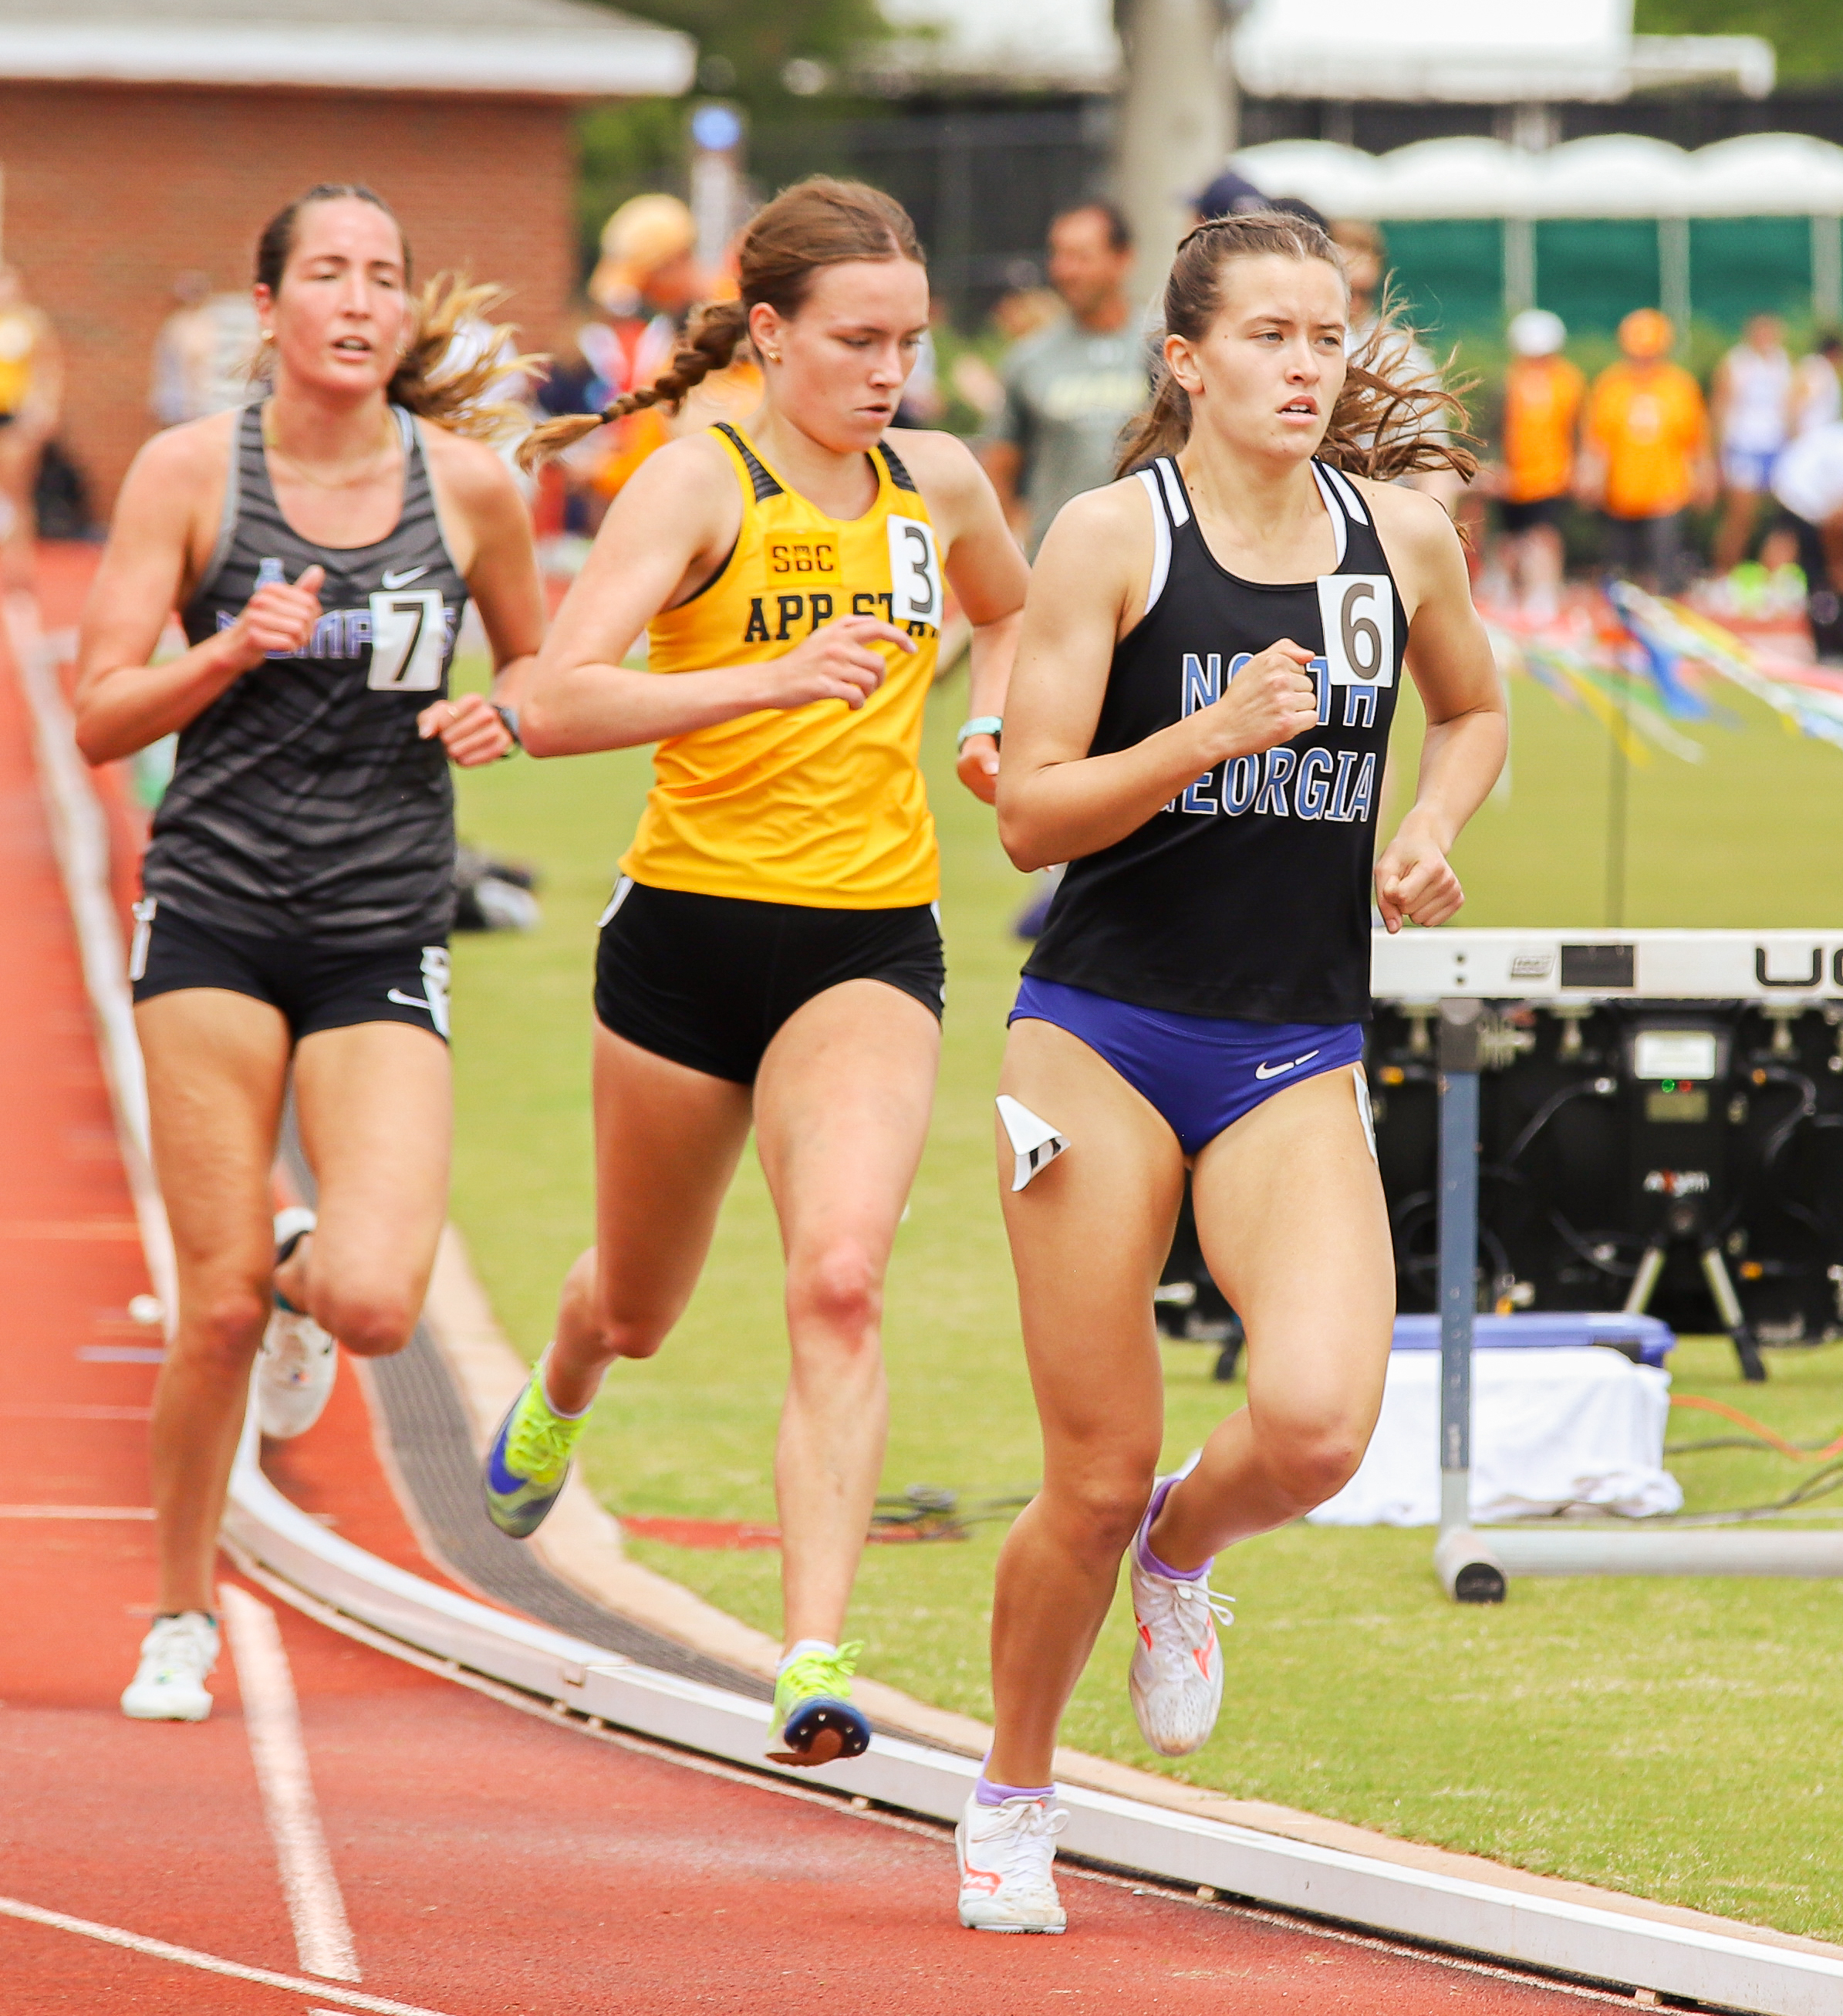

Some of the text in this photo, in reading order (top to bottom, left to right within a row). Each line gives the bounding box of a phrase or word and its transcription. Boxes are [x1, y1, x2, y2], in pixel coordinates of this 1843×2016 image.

[772, 545, 834, 572] SBC
[904, 526, 933, 614] 3
[393, 602, 424, 681] 7
[744, 593, 833, 642] APP
[1341, 583, 1382, 680] 6
[1159, 747, 1376, 822] EORGIA
[1756, 947, 1843, 987] U
